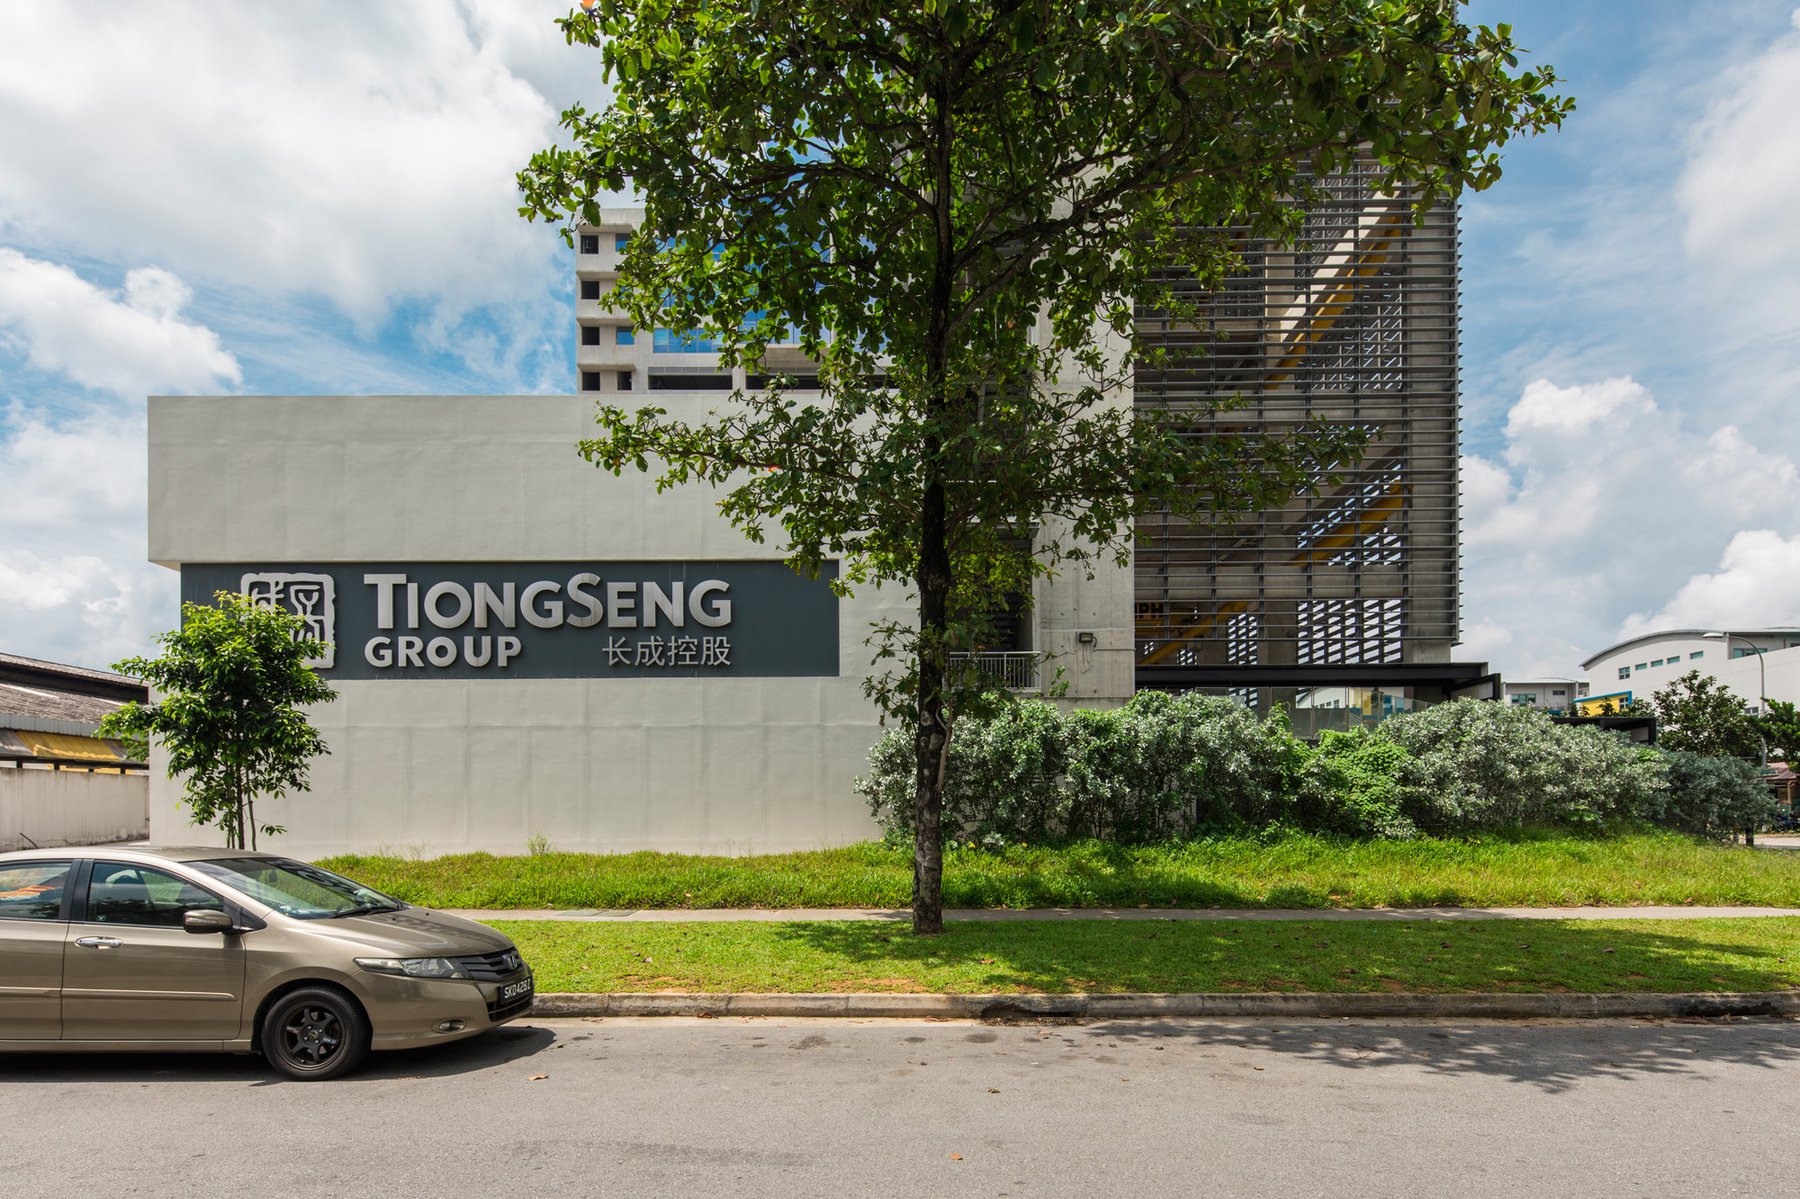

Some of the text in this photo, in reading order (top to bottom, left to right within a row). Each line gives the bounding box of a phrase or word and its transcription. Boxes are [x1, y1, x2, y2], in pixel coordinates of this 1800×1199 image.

[364, 635, 522, 668] GROUP
[602, 635, 732, 667] 长成控股
